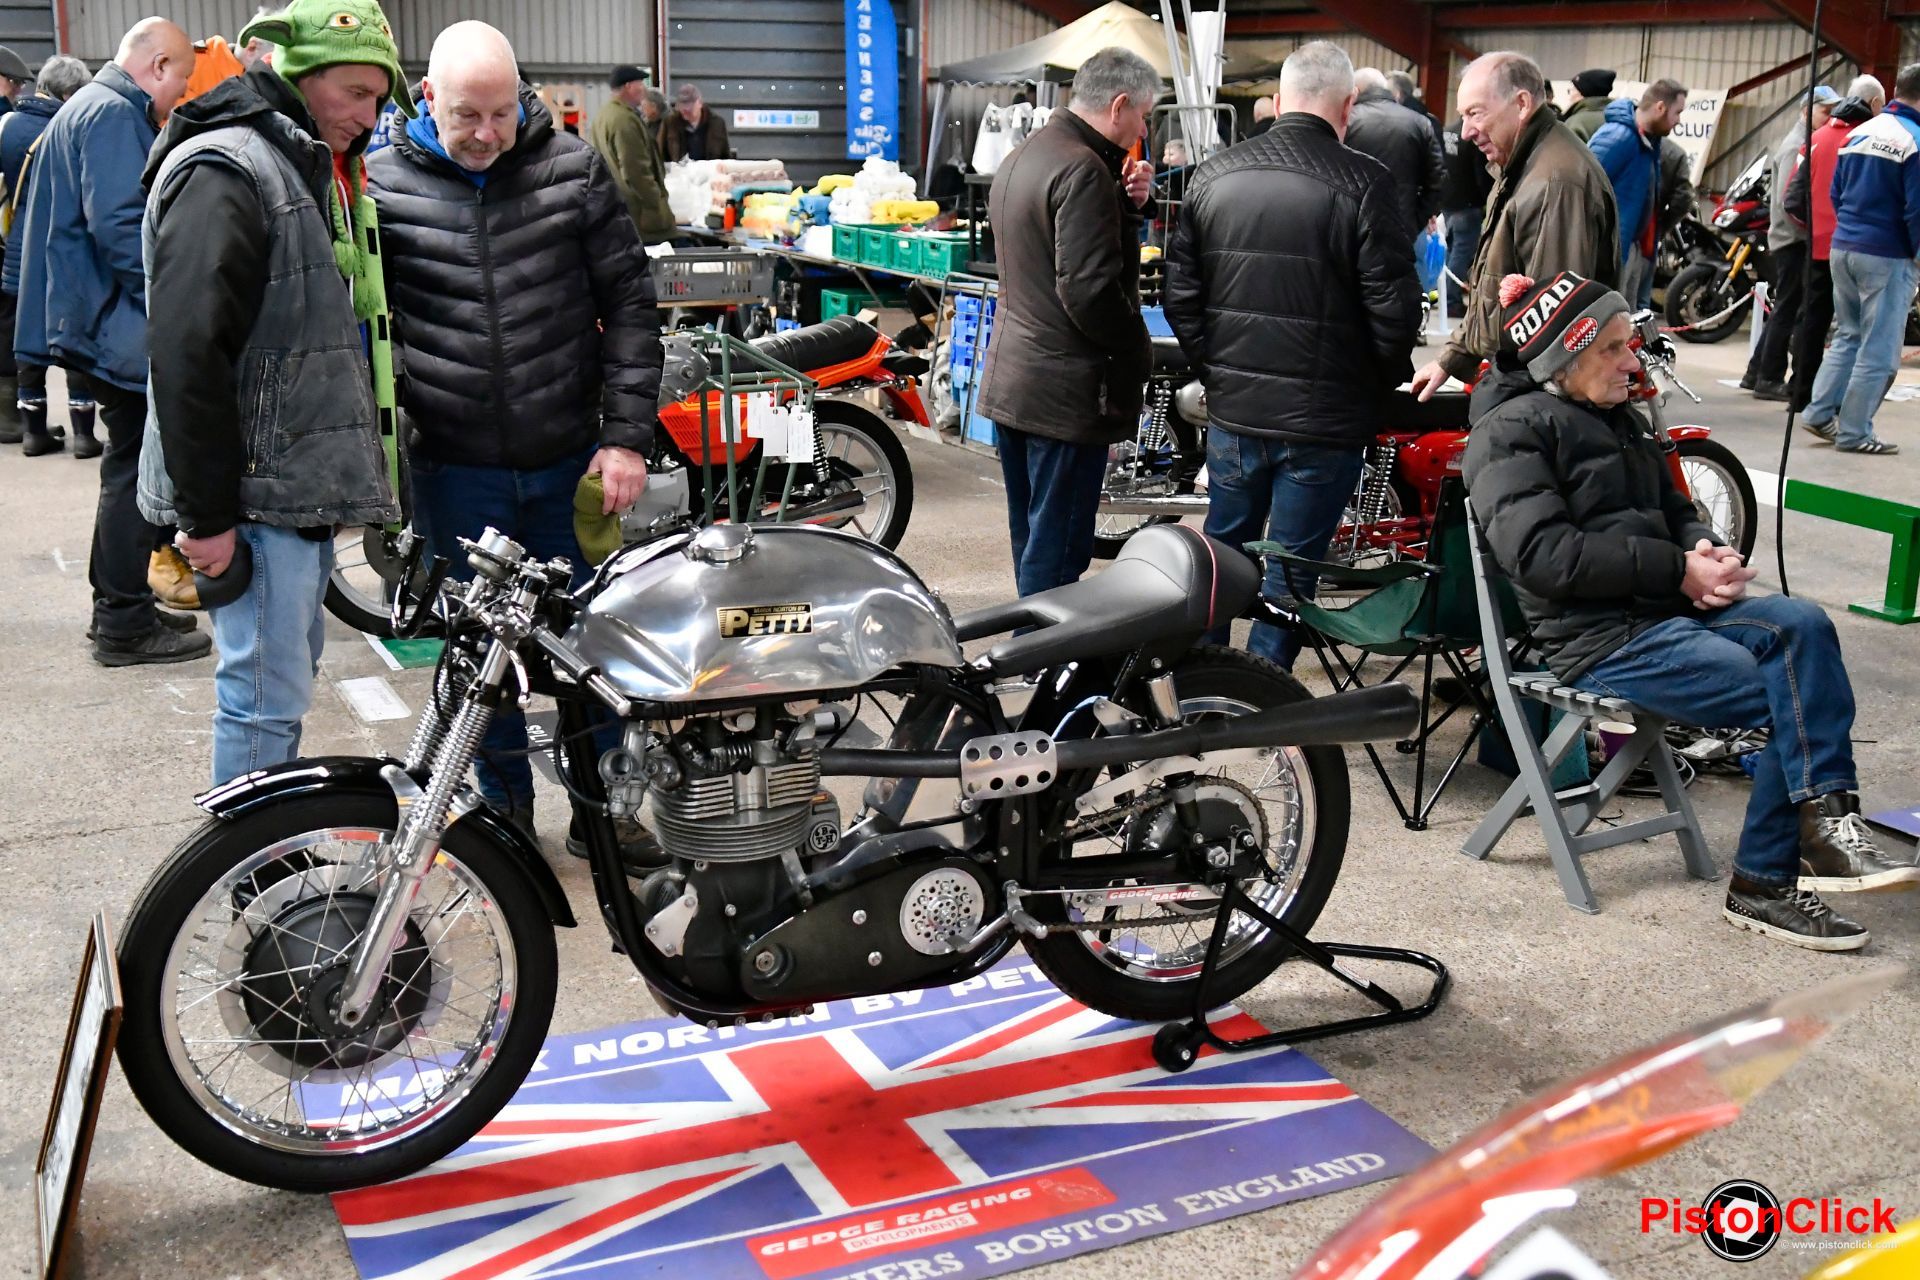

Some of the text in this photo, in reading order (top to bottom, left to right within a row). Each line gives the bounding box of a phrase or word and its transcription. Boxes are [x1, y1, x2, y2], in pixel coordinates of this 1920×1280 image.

[1871, 142, 1906, 158] SUZUKI
[1510, 279, 1575, 346] ROAD
[1109, 889, 1201, 902] GEDGE RACING
[760, 1187, 1032, 1256] GEDGE RACING
[850, 1215, 970, 1250] DEVELOPMENTS
[975, 1204, 1168, 1264] BOSTON
[1173, 1151, 1387, 1217] ENGLAND
